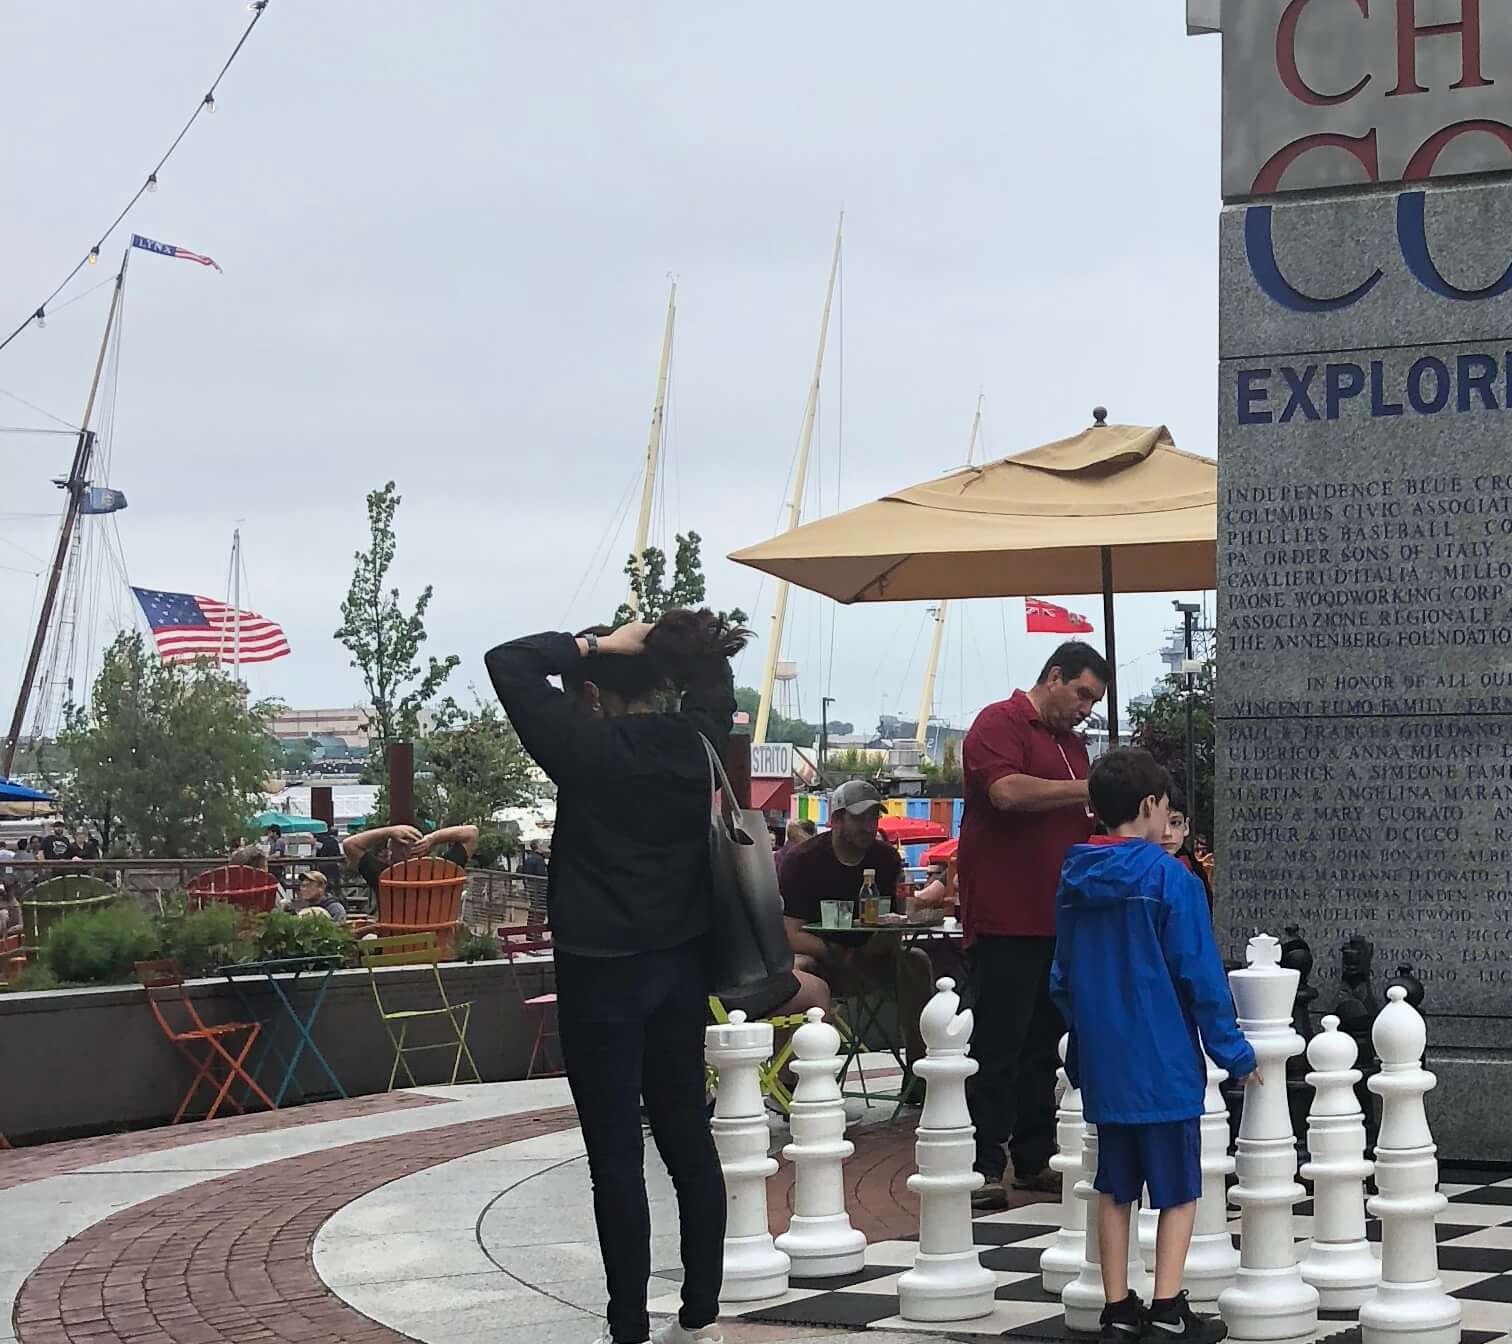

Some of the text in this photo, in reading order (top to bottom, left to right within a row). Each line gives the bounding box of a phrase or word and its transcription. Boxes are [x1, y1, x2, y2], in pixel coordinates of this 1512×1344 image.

[139, 238, 172, 255] LYNX
[1227, 479, 1393, 505] INDEPENDENCE
[1405, 475, 1462, 495] BLUE
[1226, 503, 1333, 526] COLUMBUS
[1342, 500, 1401, 520] CIVIC
[1226, 525, 1329, 547] PHILLIES
[1339, 518, 1455, 541] BASEBALL
[1262, 547, 1330, 566] ORDER
[1340, 544, 1389, 562] SONS
[1399, 542, 1424, 559] OF
[1435, 540, 1494, 559] ITALY
[1227, 568, 1326, 589] CAVALIERI
[1228, 592, 1285, 610] PAONE
[1293, 585, 1441, 607] WOODWORKING
[1228, 609, 1369, 631] ASSOCIAZIONE
[1379, 604, 1494, 625] REGIONALE
[1228, 634, 1266, 652] THE
[1273, 629, 1390, 650] ANNENBERG
[1306, 677, 1324, 691] IN
[1334, 674, 1394, 691] HONOR
[1435, 672, 1471, 687] ALL
[1232, 700, 1313, 717] VINCENT
[1380, 696, 1444, 713] FAMILY
[1349, 744, 1402, 760] ANNA
[1227, 765, 1333, 782] FREDERICK
[1370, 762, 1456, 779] SIMEONE
[1229, 786, 1303, 802] MARTIN
[1333, 784, 1432, 800] ANGELINA
[1228, 827, 1299, 843] ARTHUR
